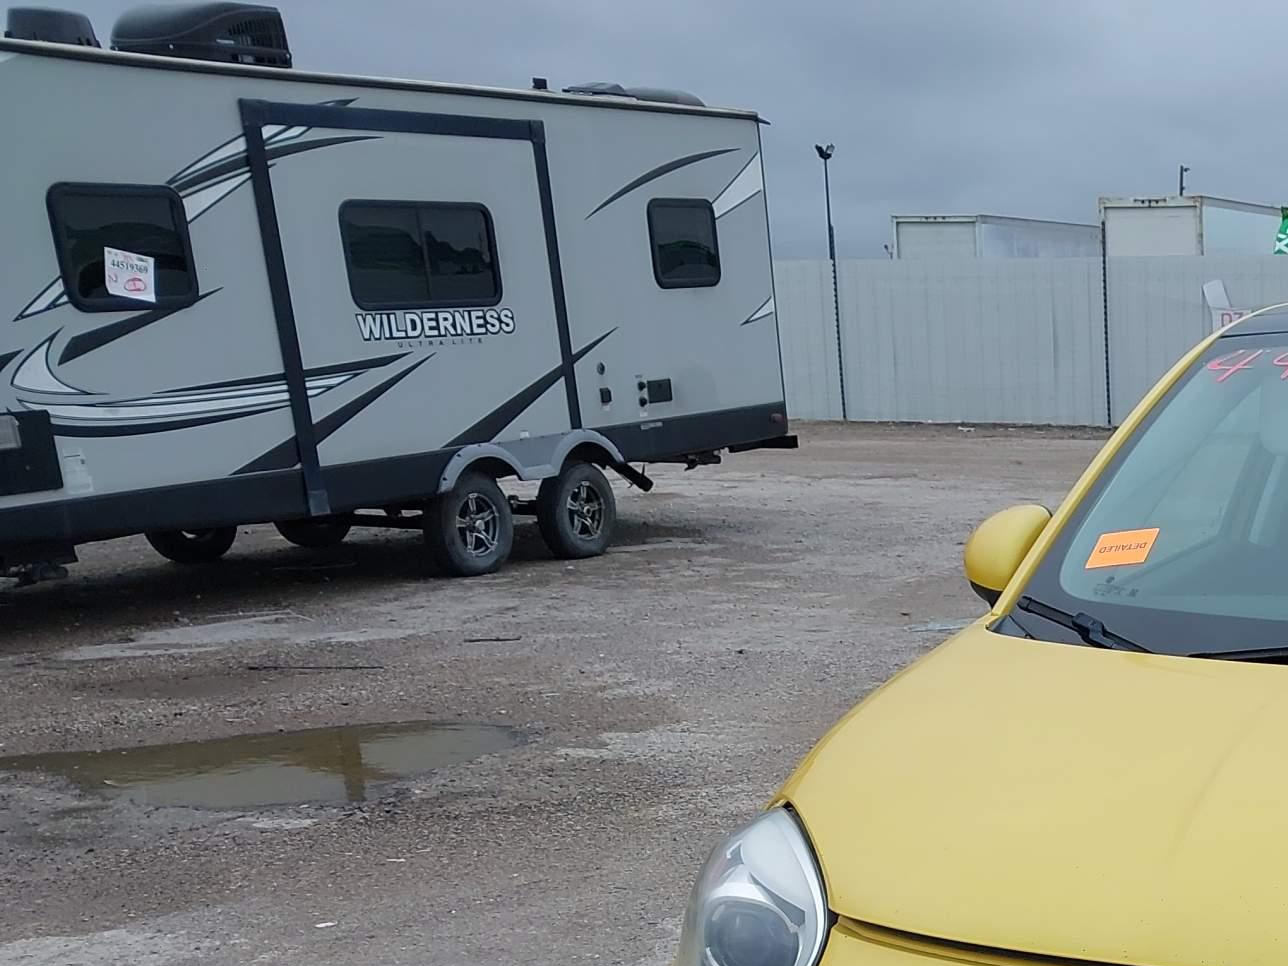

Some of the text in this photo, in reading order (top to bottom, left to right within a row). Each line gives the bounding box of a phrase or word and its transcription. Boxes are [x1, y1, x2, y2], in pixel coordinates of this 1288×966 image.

[355, 308, 515, 341] WILDERNESS
[397, 340, 444, 348] ULTRA
[1099, 542, 1147, 553] DETAILED
